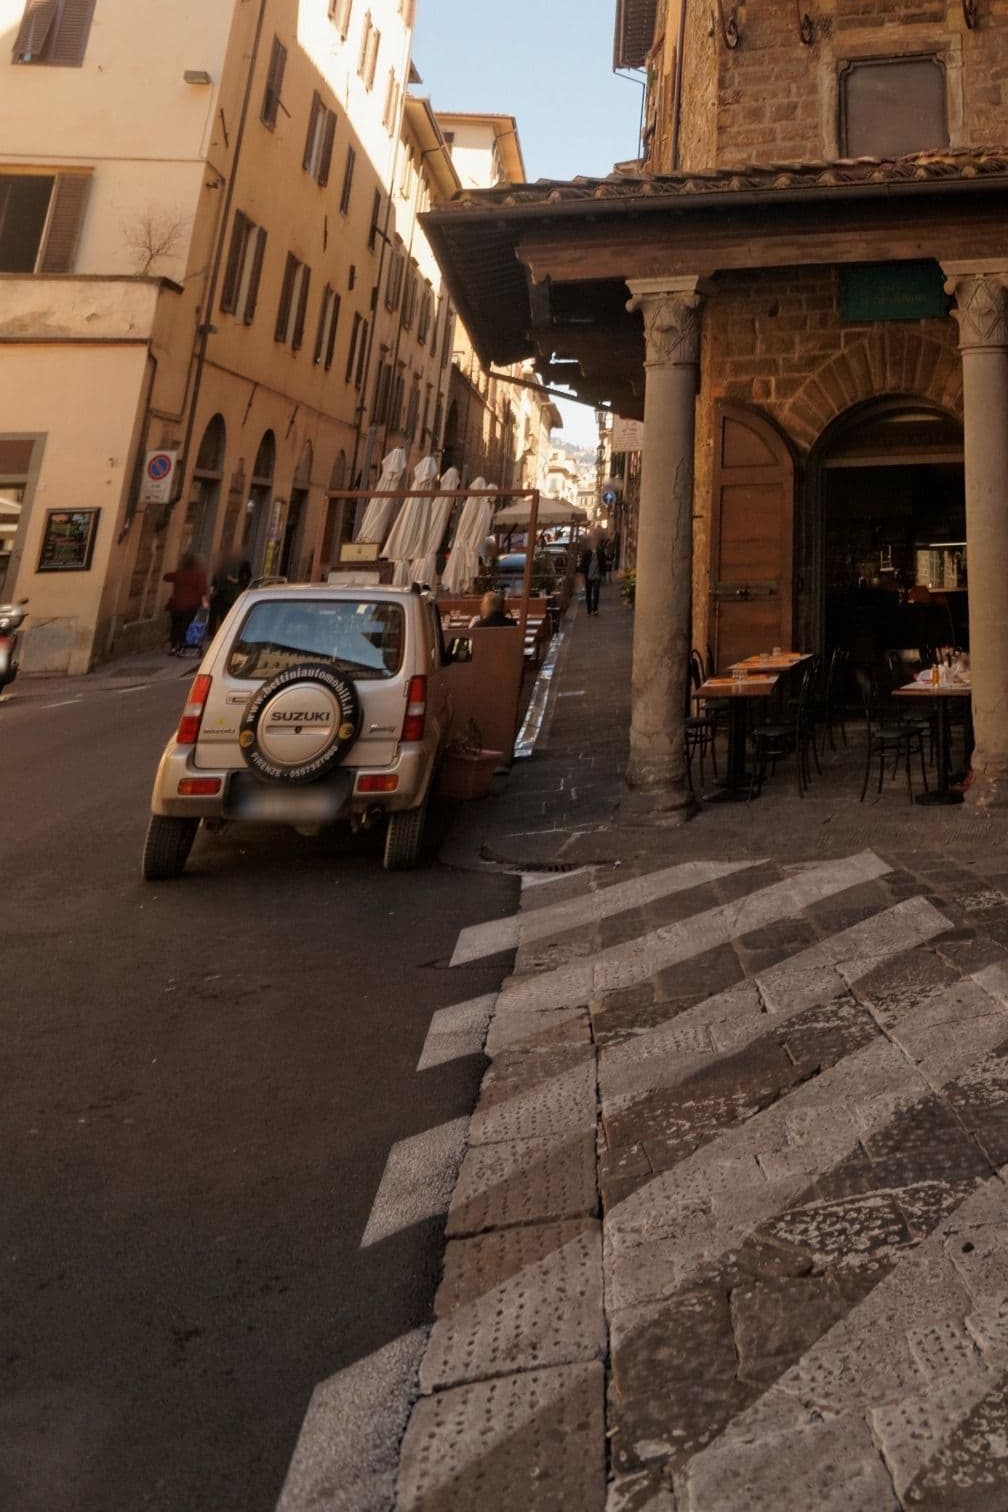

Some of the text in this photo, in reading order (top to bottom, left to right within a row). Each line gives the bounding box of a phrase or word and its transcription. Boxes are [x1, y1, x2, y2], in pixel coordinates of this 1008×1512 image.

[246, 666, 353, 723] www.bettiniautomobili.it
[271, 711, 330, 721] SUZUKI
[250, 751, 282, 778] FIRENZE
